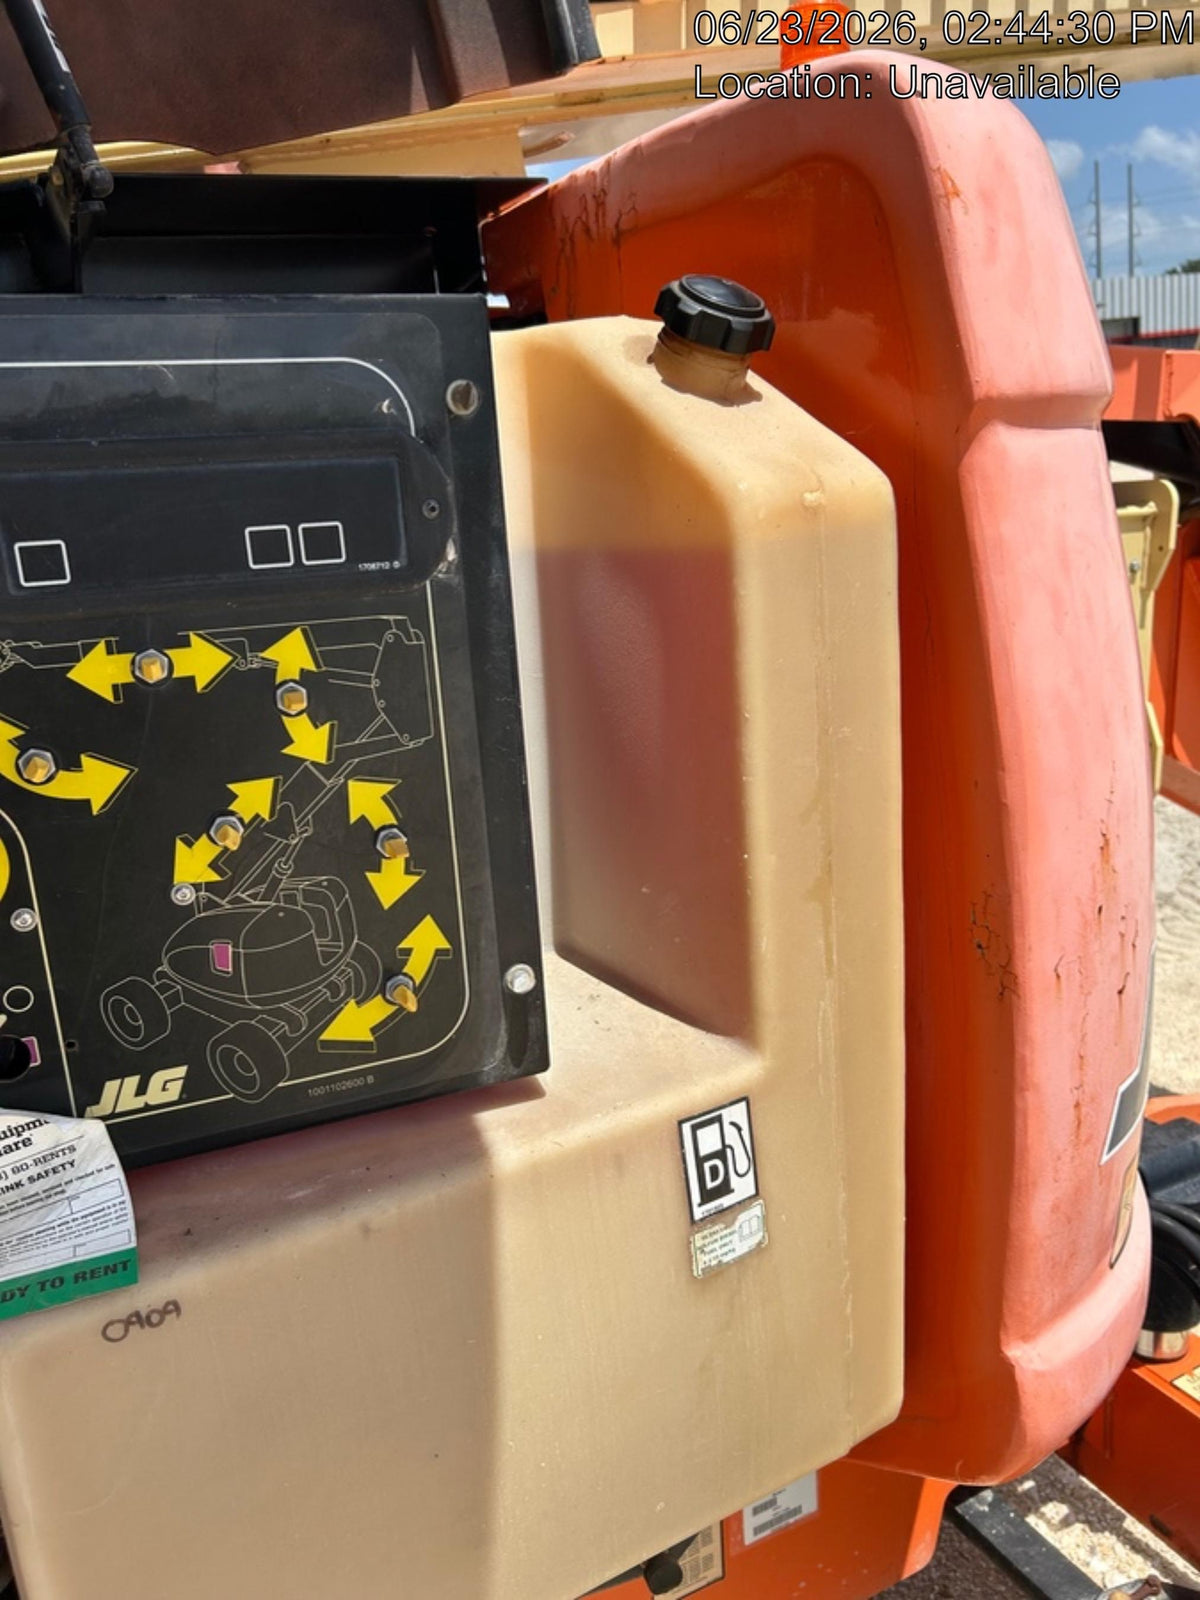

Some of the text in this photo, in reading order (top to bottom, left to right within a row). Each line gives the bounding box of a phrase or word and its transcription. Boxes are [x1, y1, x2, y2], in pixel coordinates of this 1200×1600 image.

[84, 1065, 189, 1118] JLG
[27, 1158, 76, 1185] SAFETY
[703, 1158, 725, 1190] D
[37, 1275, 65, 1294] TO
[73, 1258, 131, 1285] RENT
